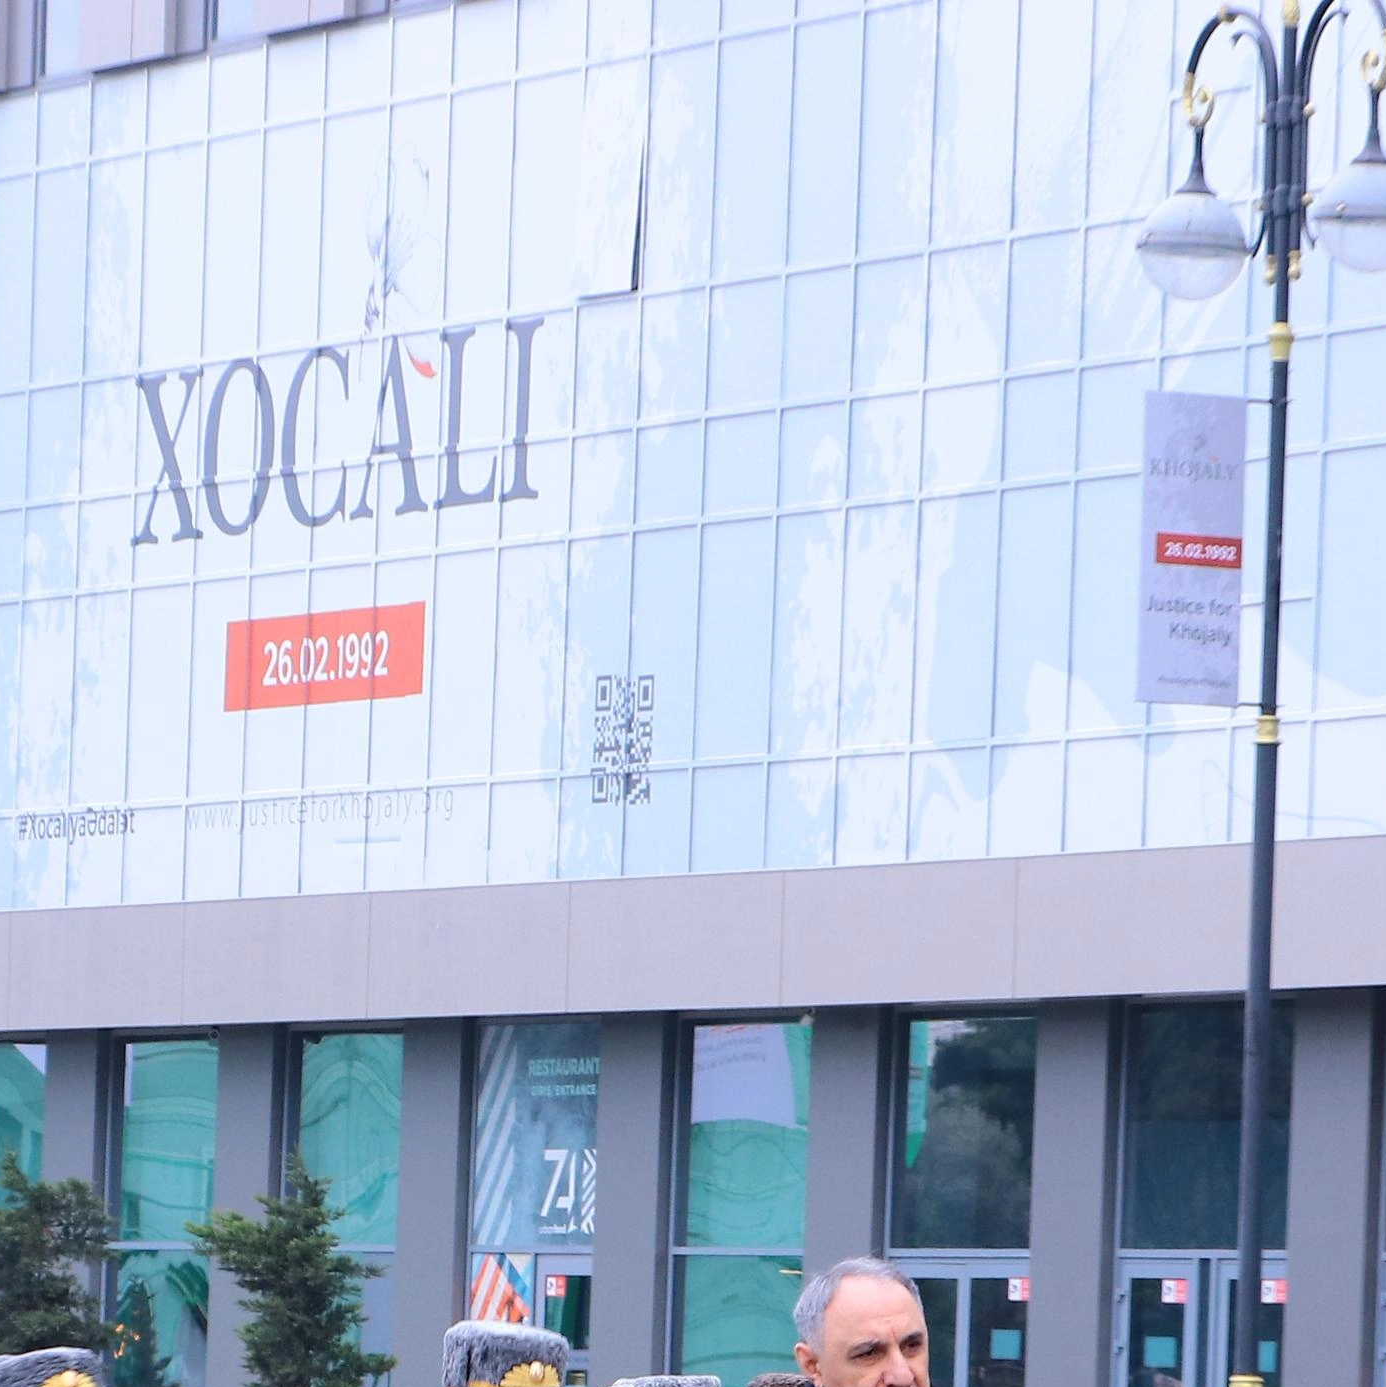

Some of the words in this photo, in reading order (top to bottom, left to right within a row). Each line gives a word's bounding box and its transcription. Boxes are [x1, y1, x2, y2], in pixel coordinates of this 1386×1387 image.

[130, 317, 545, 547] XOCALI
[1149, 457, 1239, 483] KHOJALY
[1164, 541, 1238, 560] 26.02.1992
[1146, 595, 1206, 615] Justice
[1208, 599, 1233, 616] for
[1169, 622, 1232, 647] Khojaly
[261, 631, 390, 687] 26.02.1992
[186, 786, 454, 834] www.justiceforkhojaly.org
[528, 1057, 600, 1077] RESTAURANT
